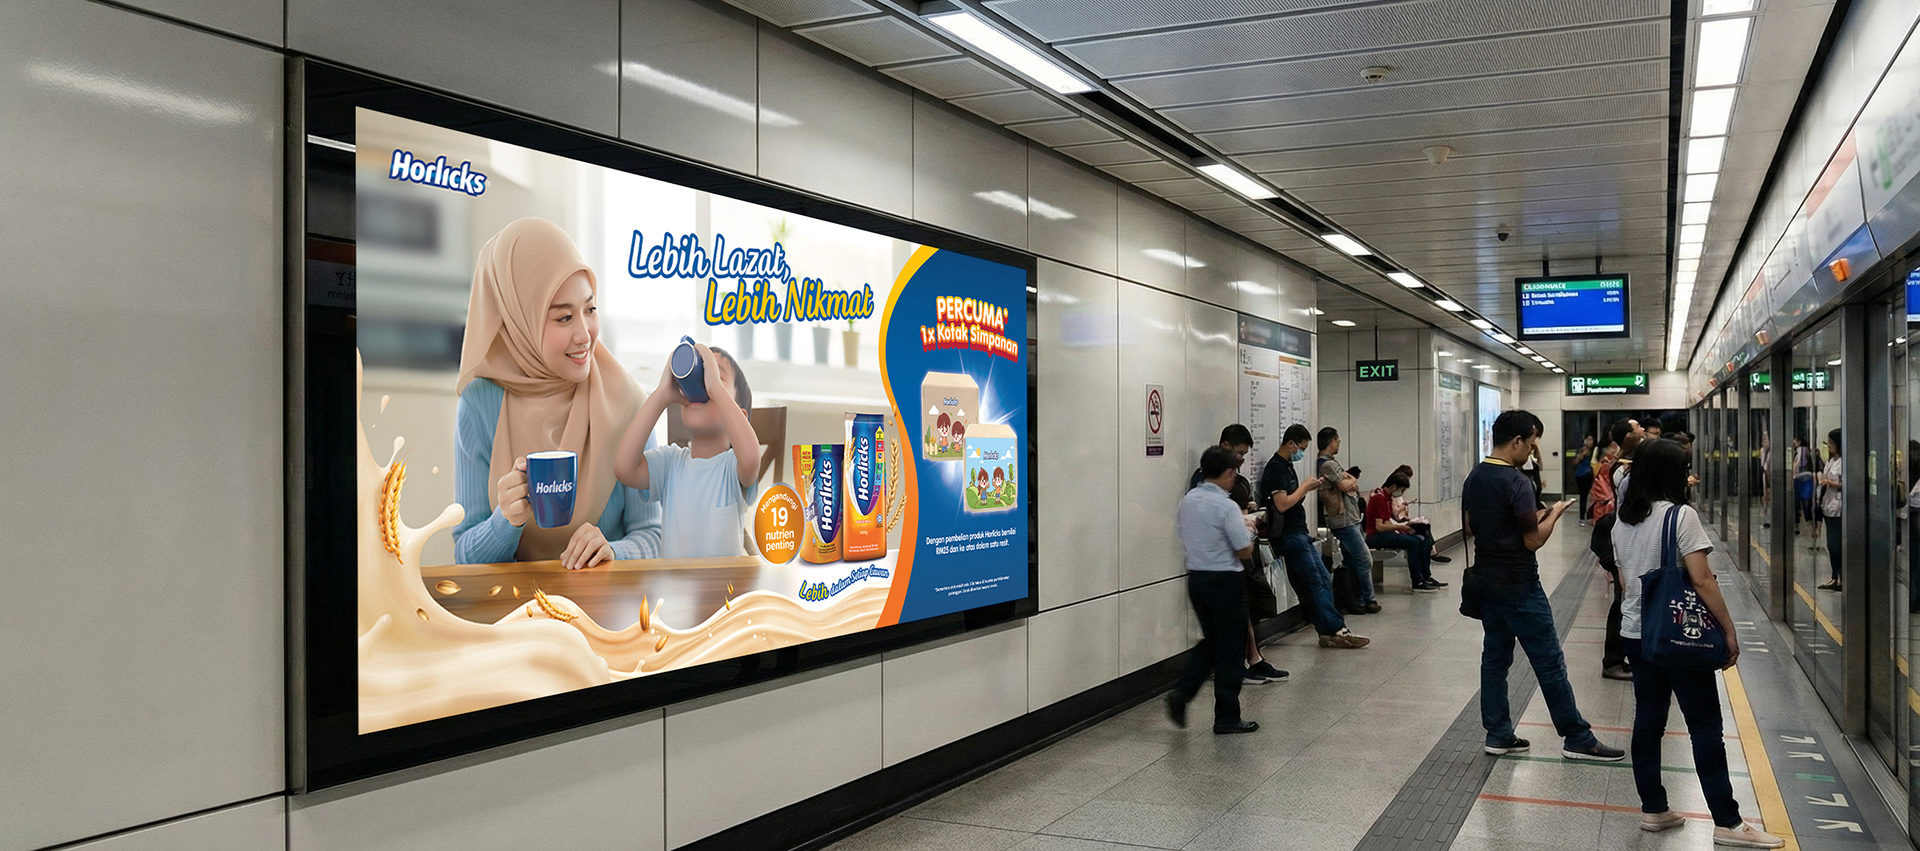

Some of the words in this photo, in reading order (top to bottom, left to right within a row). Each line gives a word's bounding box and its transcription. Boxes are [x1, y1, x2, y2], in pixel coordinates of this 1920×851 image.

[388, 149, 488, 197] Horlicks
[628, 230, 710, 278] Lebih
[712, 234, 791, 284] Lazat,
[704, 277, 782, 326] Lebih
[783, 277, 874, 323] Nikmat
[920, 325, 936, 351] 1x
[937, 322, 969, 348] Kotak
[970, 324, 1019, 361] Simpanan
[1360, 365, 1395, 378] EXIT
[857, 436, 869, 501] Horlicks
[536, 479, 573, 494] Horlicks
[819, 459, 833, 531] Horlicks
[760, 493, 799, 514] Mengandungi
[771, 506, 788, 527] 19
[765, 528, 795, 541] nutrien
[926, 536, 945, 546] Dengan
[969, 531, 985, 541] produk
[765, 540, 795, 553] penting
[949, 545, 959, 553] dan
[798, 580, 829, 602] Lebih
